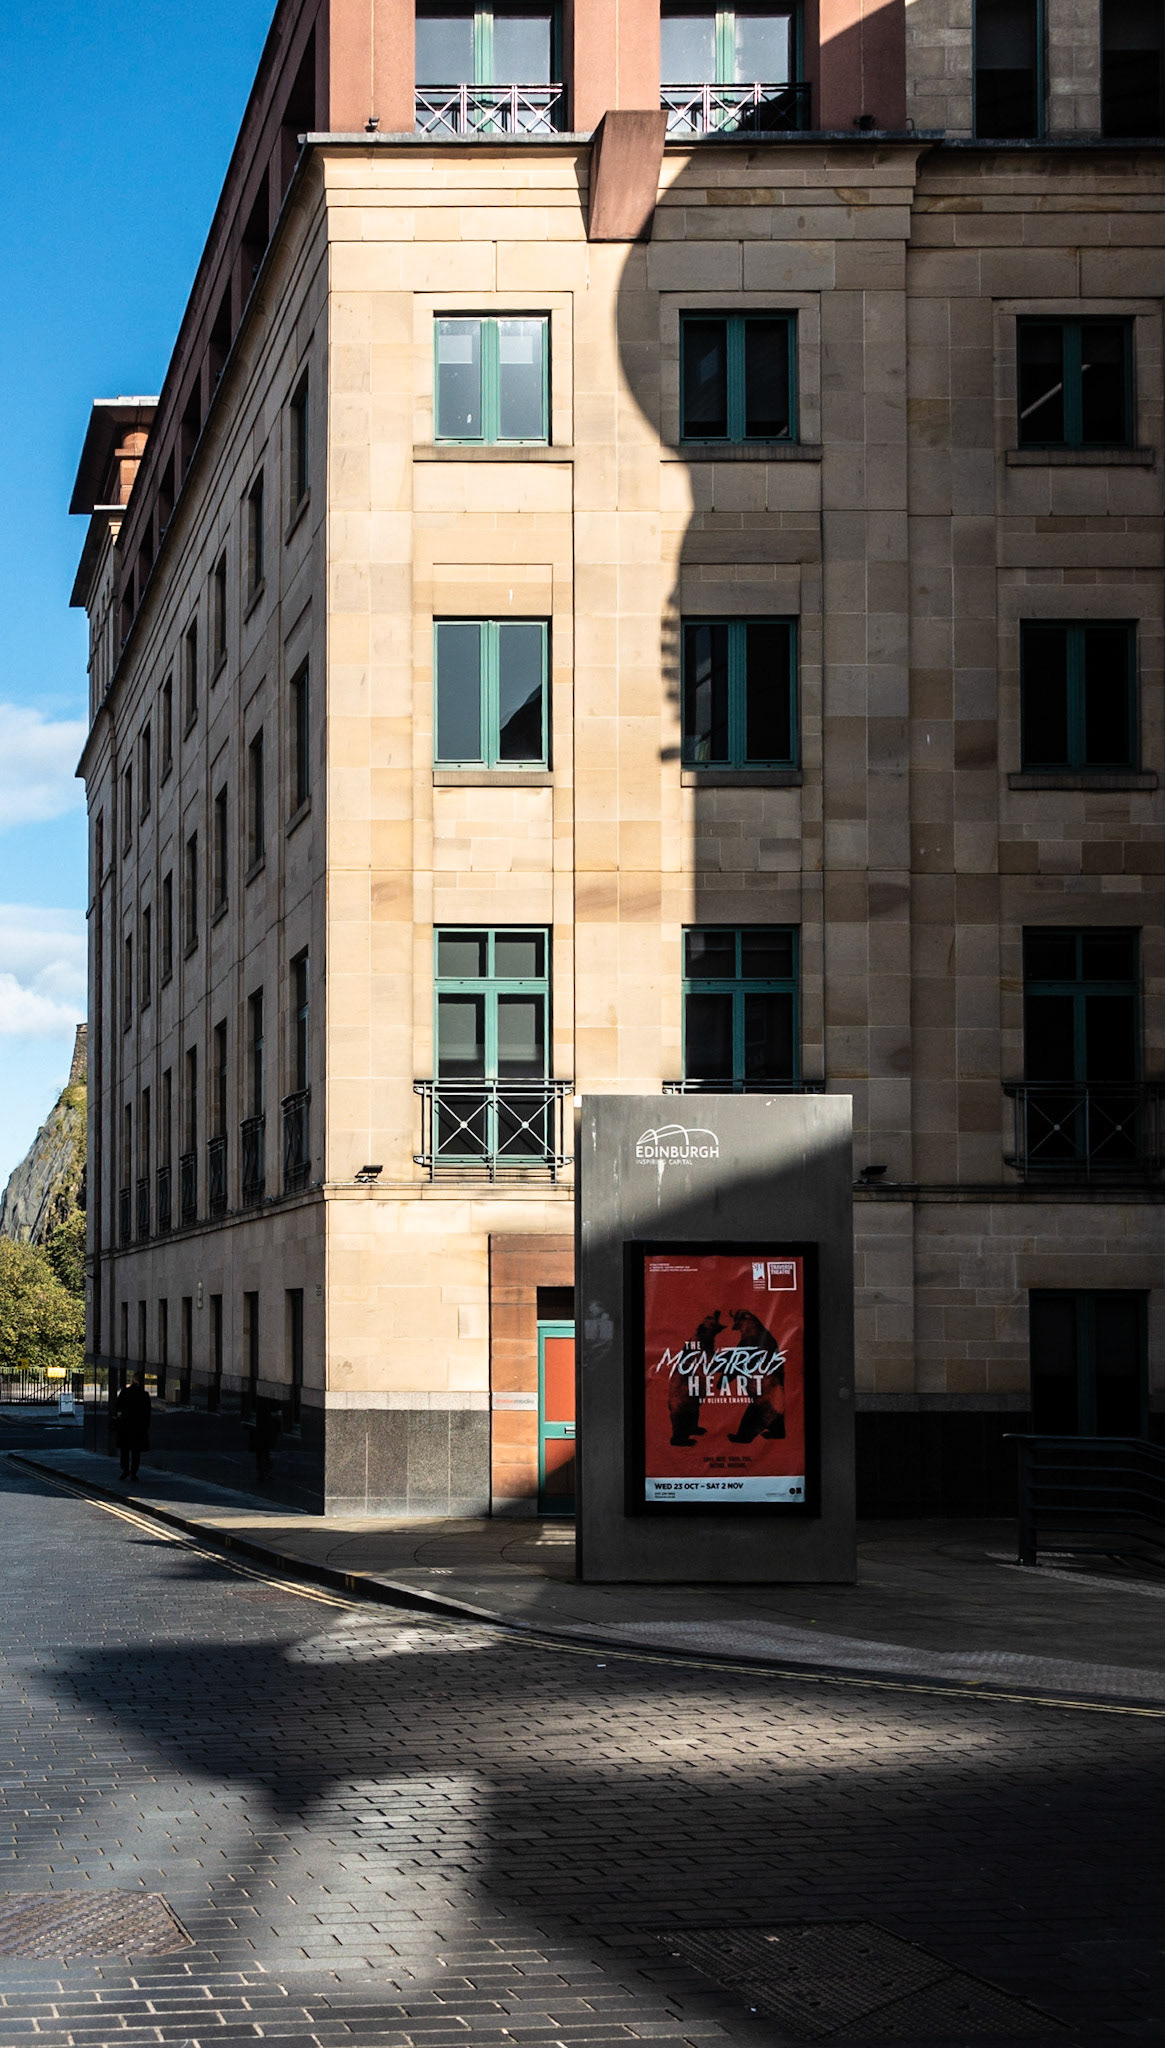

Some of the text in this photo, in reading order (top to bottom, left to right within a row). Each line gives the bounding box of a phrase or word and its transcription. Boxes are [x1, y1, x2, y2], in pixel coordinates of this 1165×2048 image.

[635, 1145, 719, 1158] EDINBURGH
[668, 1158, 693, 1166] CAPITAL
[684, 1340, 702, 1350] THE
[655, 1346, 789, 1380] MONSTROUS
[687, 1374, 764, 1396] HEART
[706, 1482, 720, 1490] SAT
